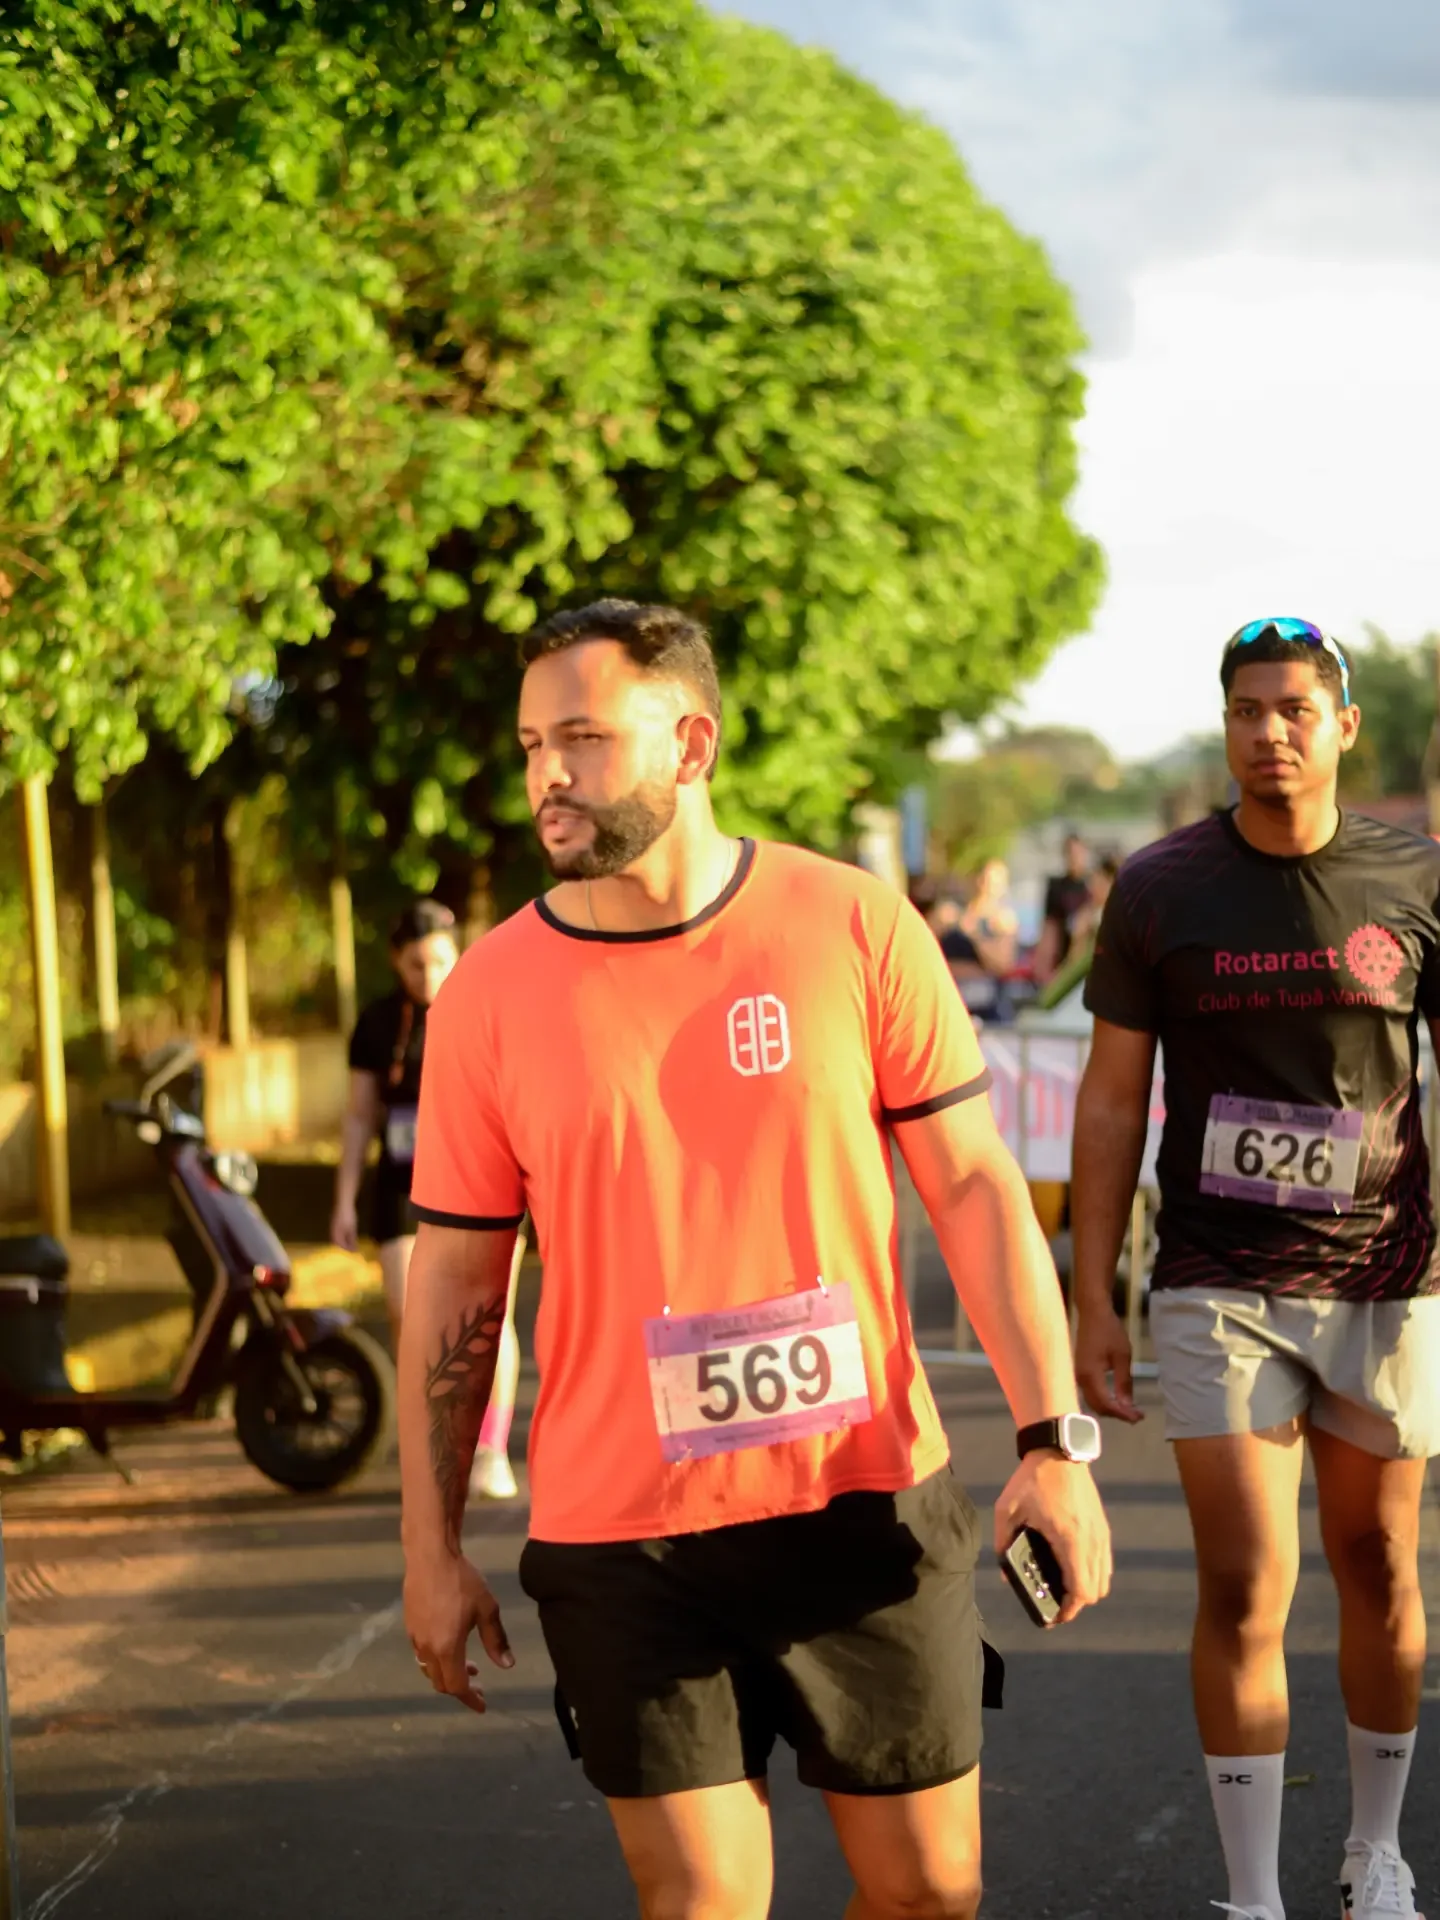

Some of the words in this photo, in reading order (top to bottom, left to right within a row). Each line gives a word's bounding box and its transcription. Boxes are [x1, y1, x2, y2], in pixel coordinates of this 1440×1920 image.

[1213, 947, 1340, 976] Rotaract
[1197, 991, 1241, 1012] Club
[1246, 989, 1271, 1009] de
[1233, 1128, 1334, 1188] 626
[696, 1334, 832, 1423] 569
